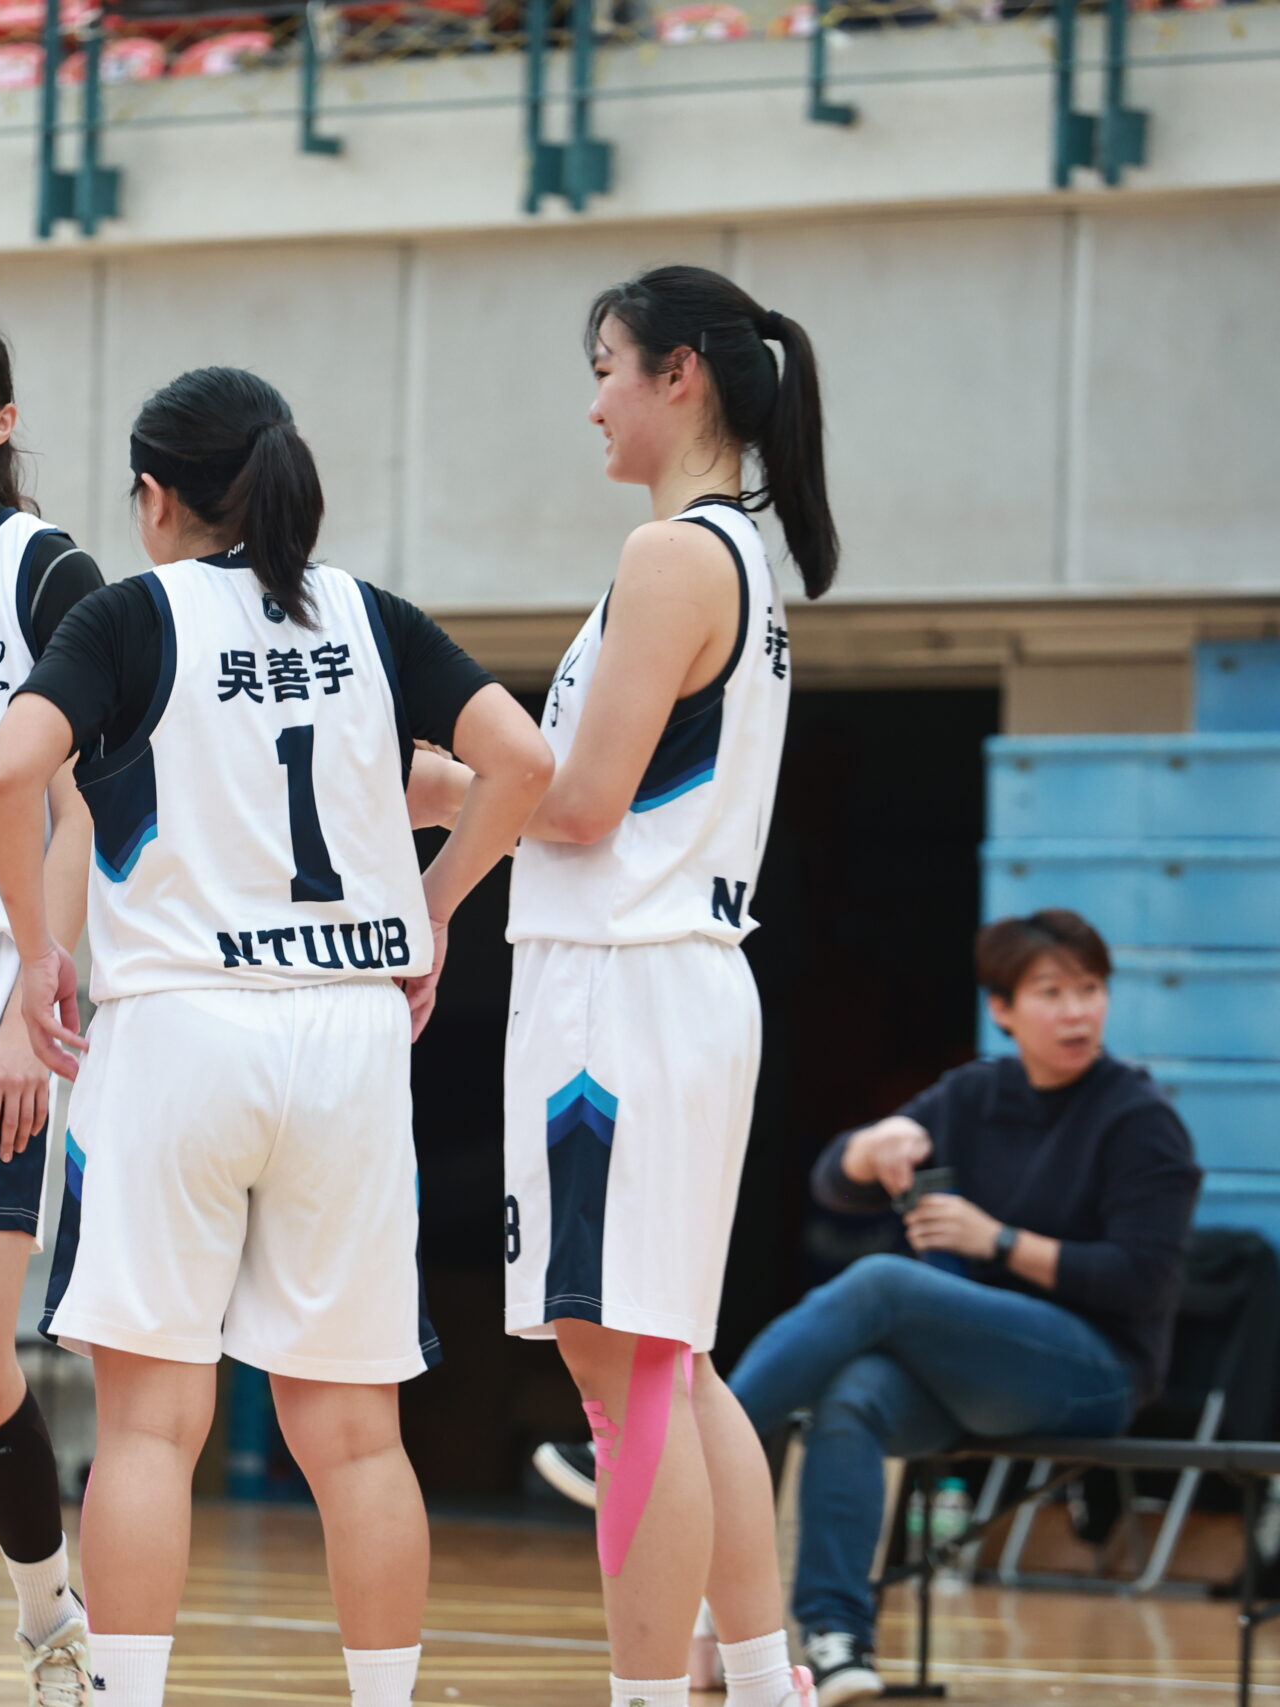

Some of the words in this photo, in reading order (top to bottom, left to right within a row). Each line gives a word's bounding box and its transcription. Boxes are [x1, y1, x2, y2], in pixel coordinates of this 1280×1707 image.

[217, 641, 354, 704] 吳善宇
[275, 724, 345, 903] 1
